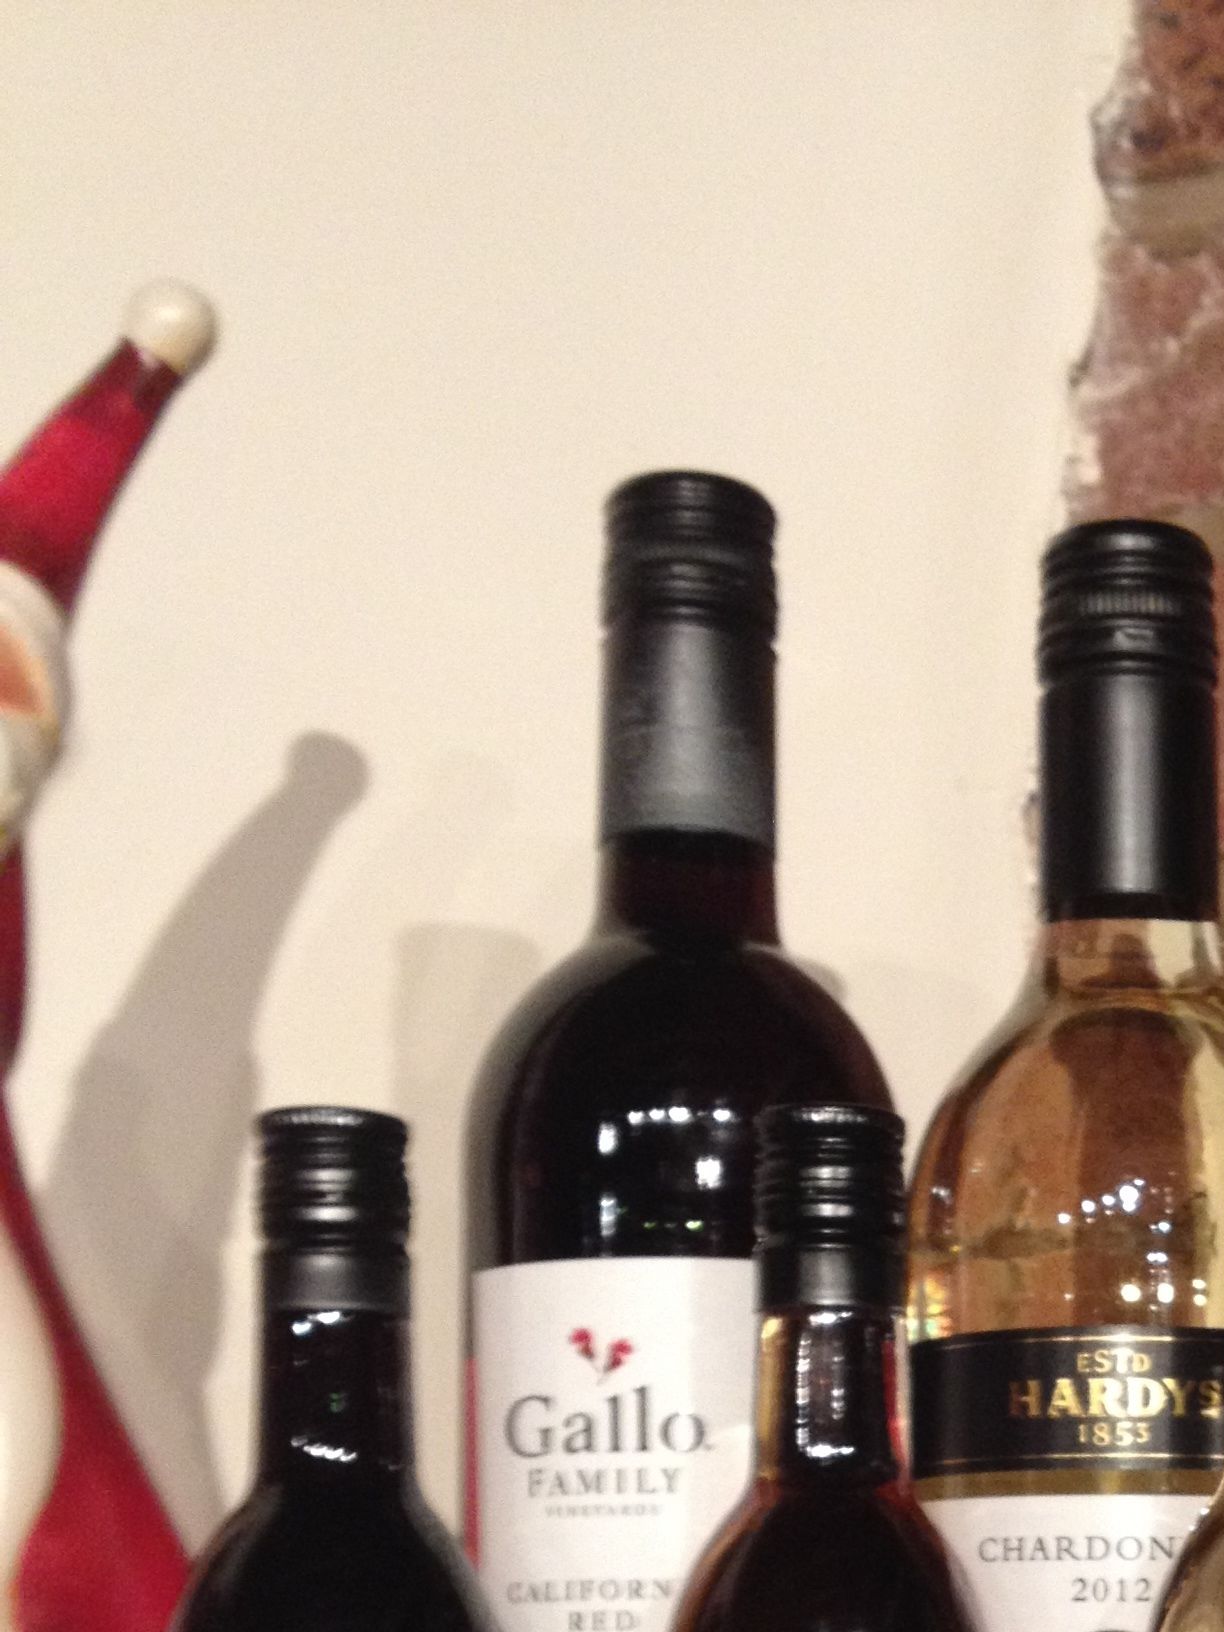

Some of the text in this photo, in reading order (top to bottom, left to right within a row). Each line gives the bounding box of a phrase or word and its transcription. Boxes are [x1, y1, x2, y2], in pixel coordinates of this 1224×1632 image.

[1077, 1350, 1151, 1374] ESTD
[1008, 1377, 1222, 1419] HARDYS
[504, 1386, 713, 1458] Gallo
[1079, 1421, 1151, 1446] 1853
[527, 1468, 683, 1498] FAMILY
[976, 1536, 1181, 1562] CHARDON
[1072, 1578, 1152, 1602] 2012
[567, 1611, 640, 1632] RED
